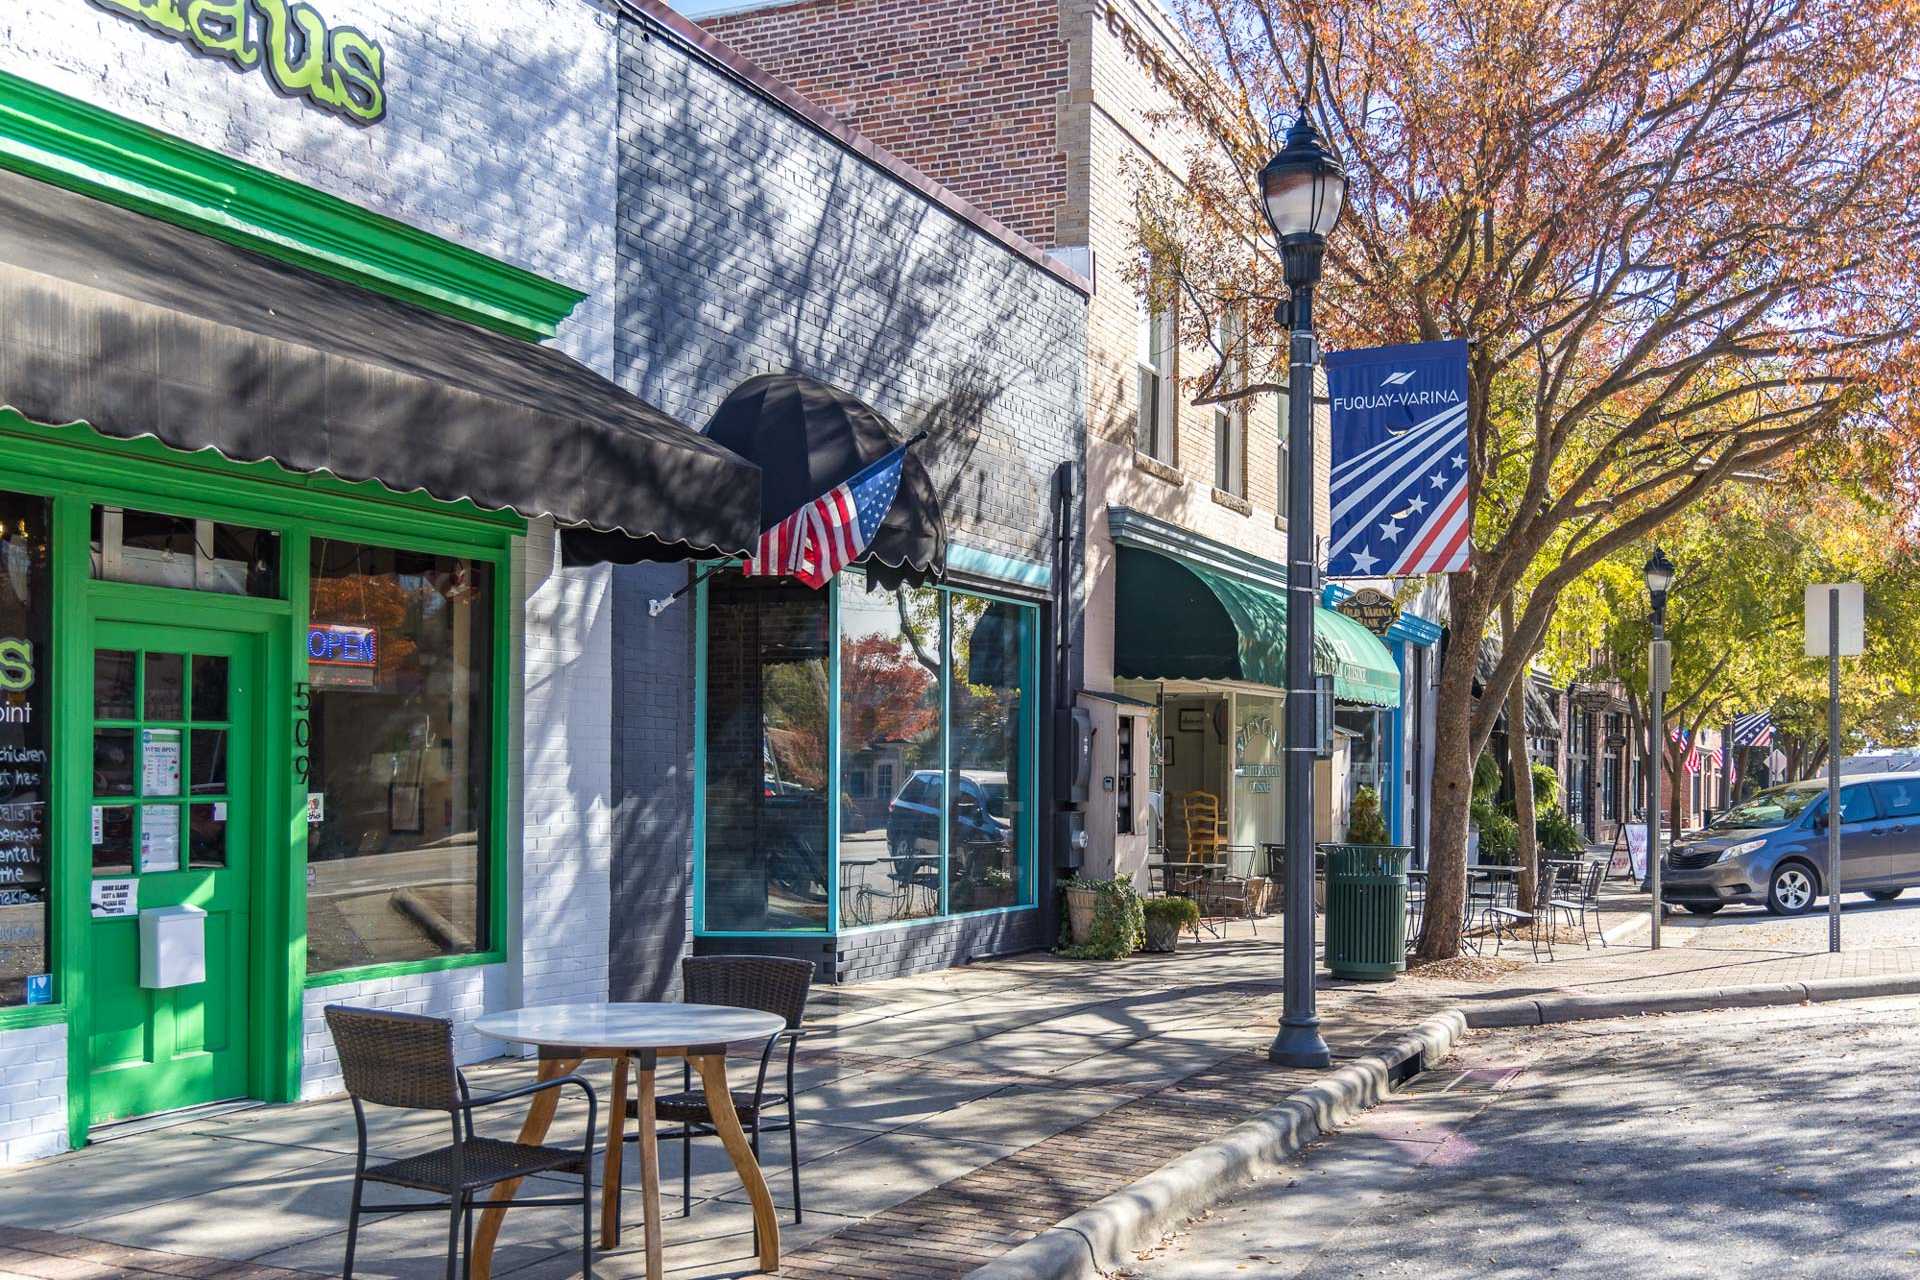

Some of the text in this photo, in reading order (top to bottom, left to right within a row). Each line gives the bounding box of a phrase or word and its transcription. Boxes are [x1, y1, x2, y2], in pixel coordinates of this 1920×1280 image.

[88, 0, 386, 127] aus
[1333, 389, 1460, 411] FUQUAY-VARINA
[309, 630, 375, 661] OPEN
[295, 682, 312, 785] 509
